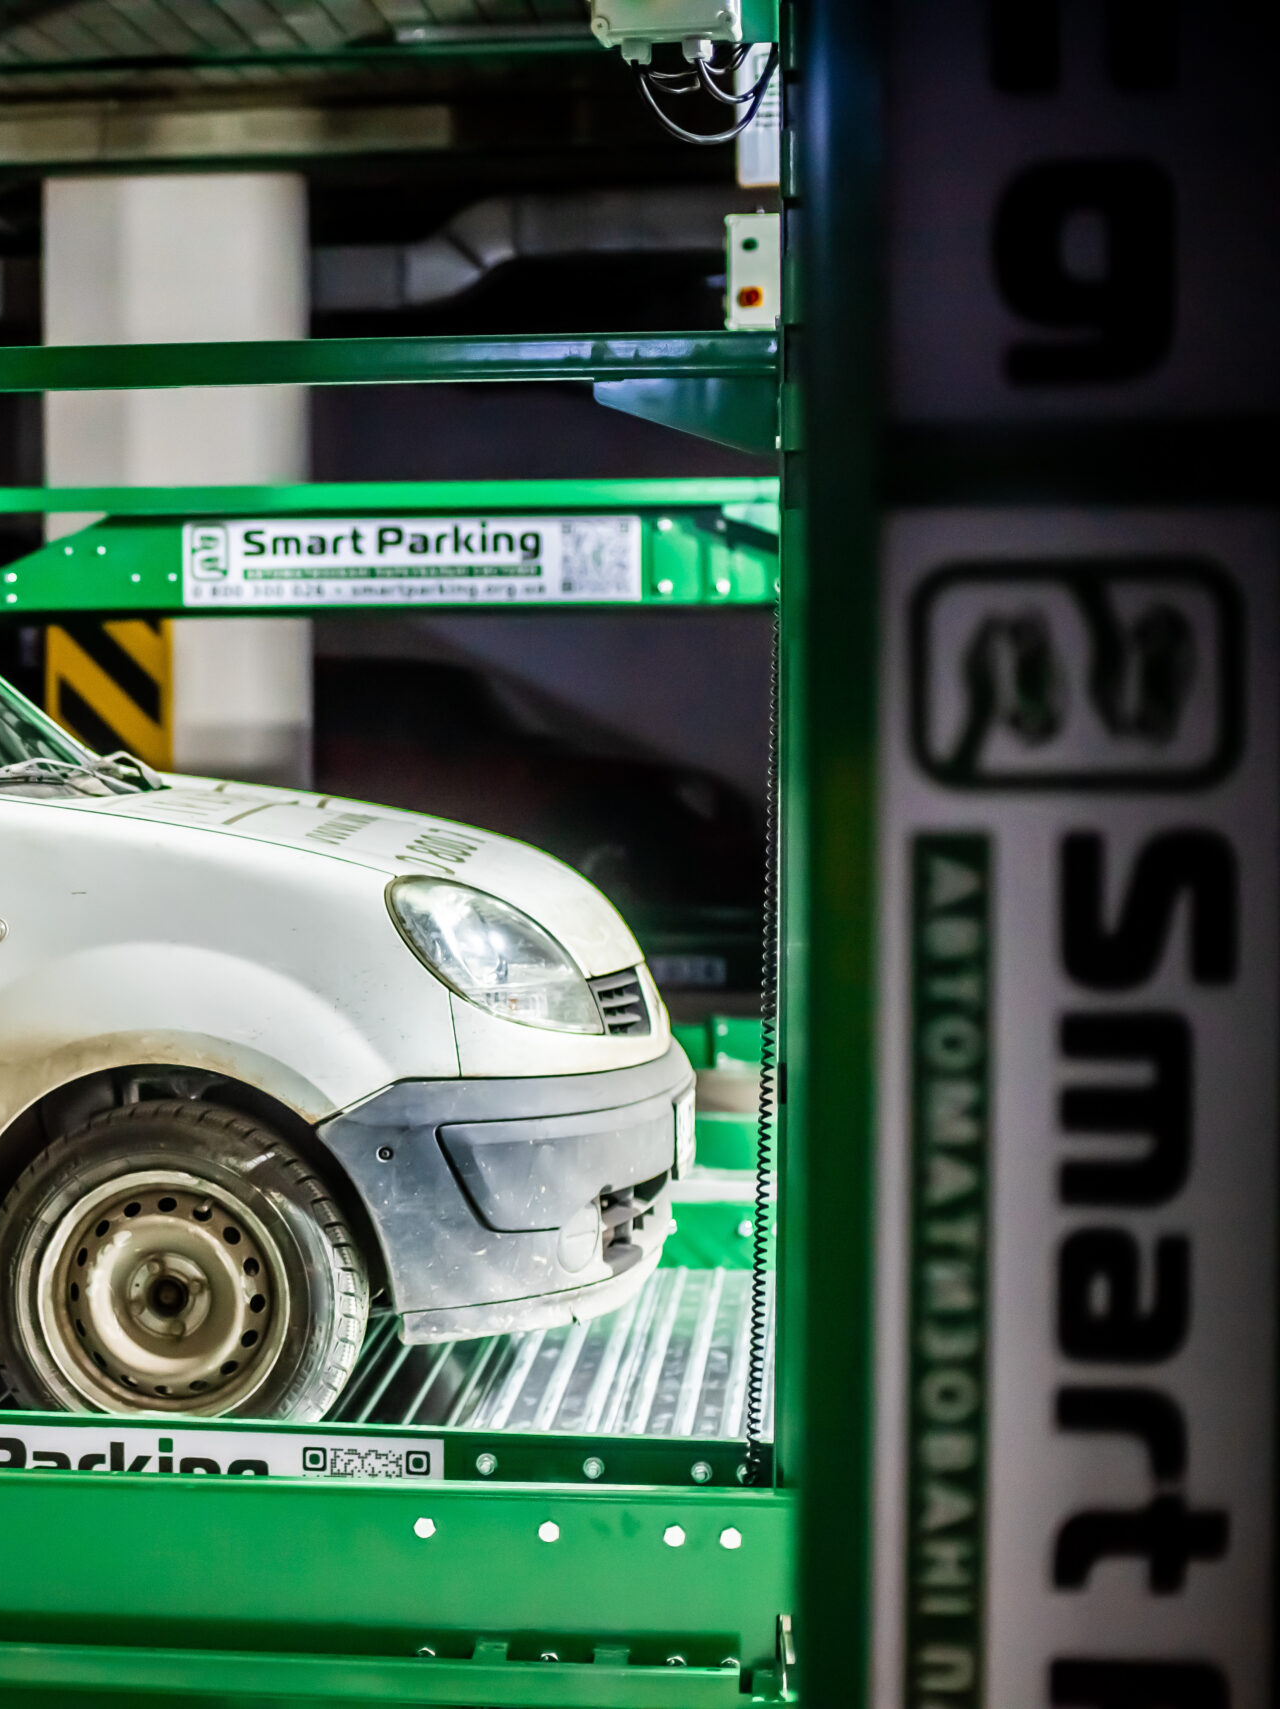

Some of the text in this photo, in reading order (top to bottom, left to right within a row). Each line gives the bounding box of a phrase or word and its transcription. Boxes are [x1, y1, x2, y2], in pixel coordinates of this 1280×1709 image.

[243, 521, 542, 560] Smart Parking
[1050, 824, 1241, 1595] Smart
